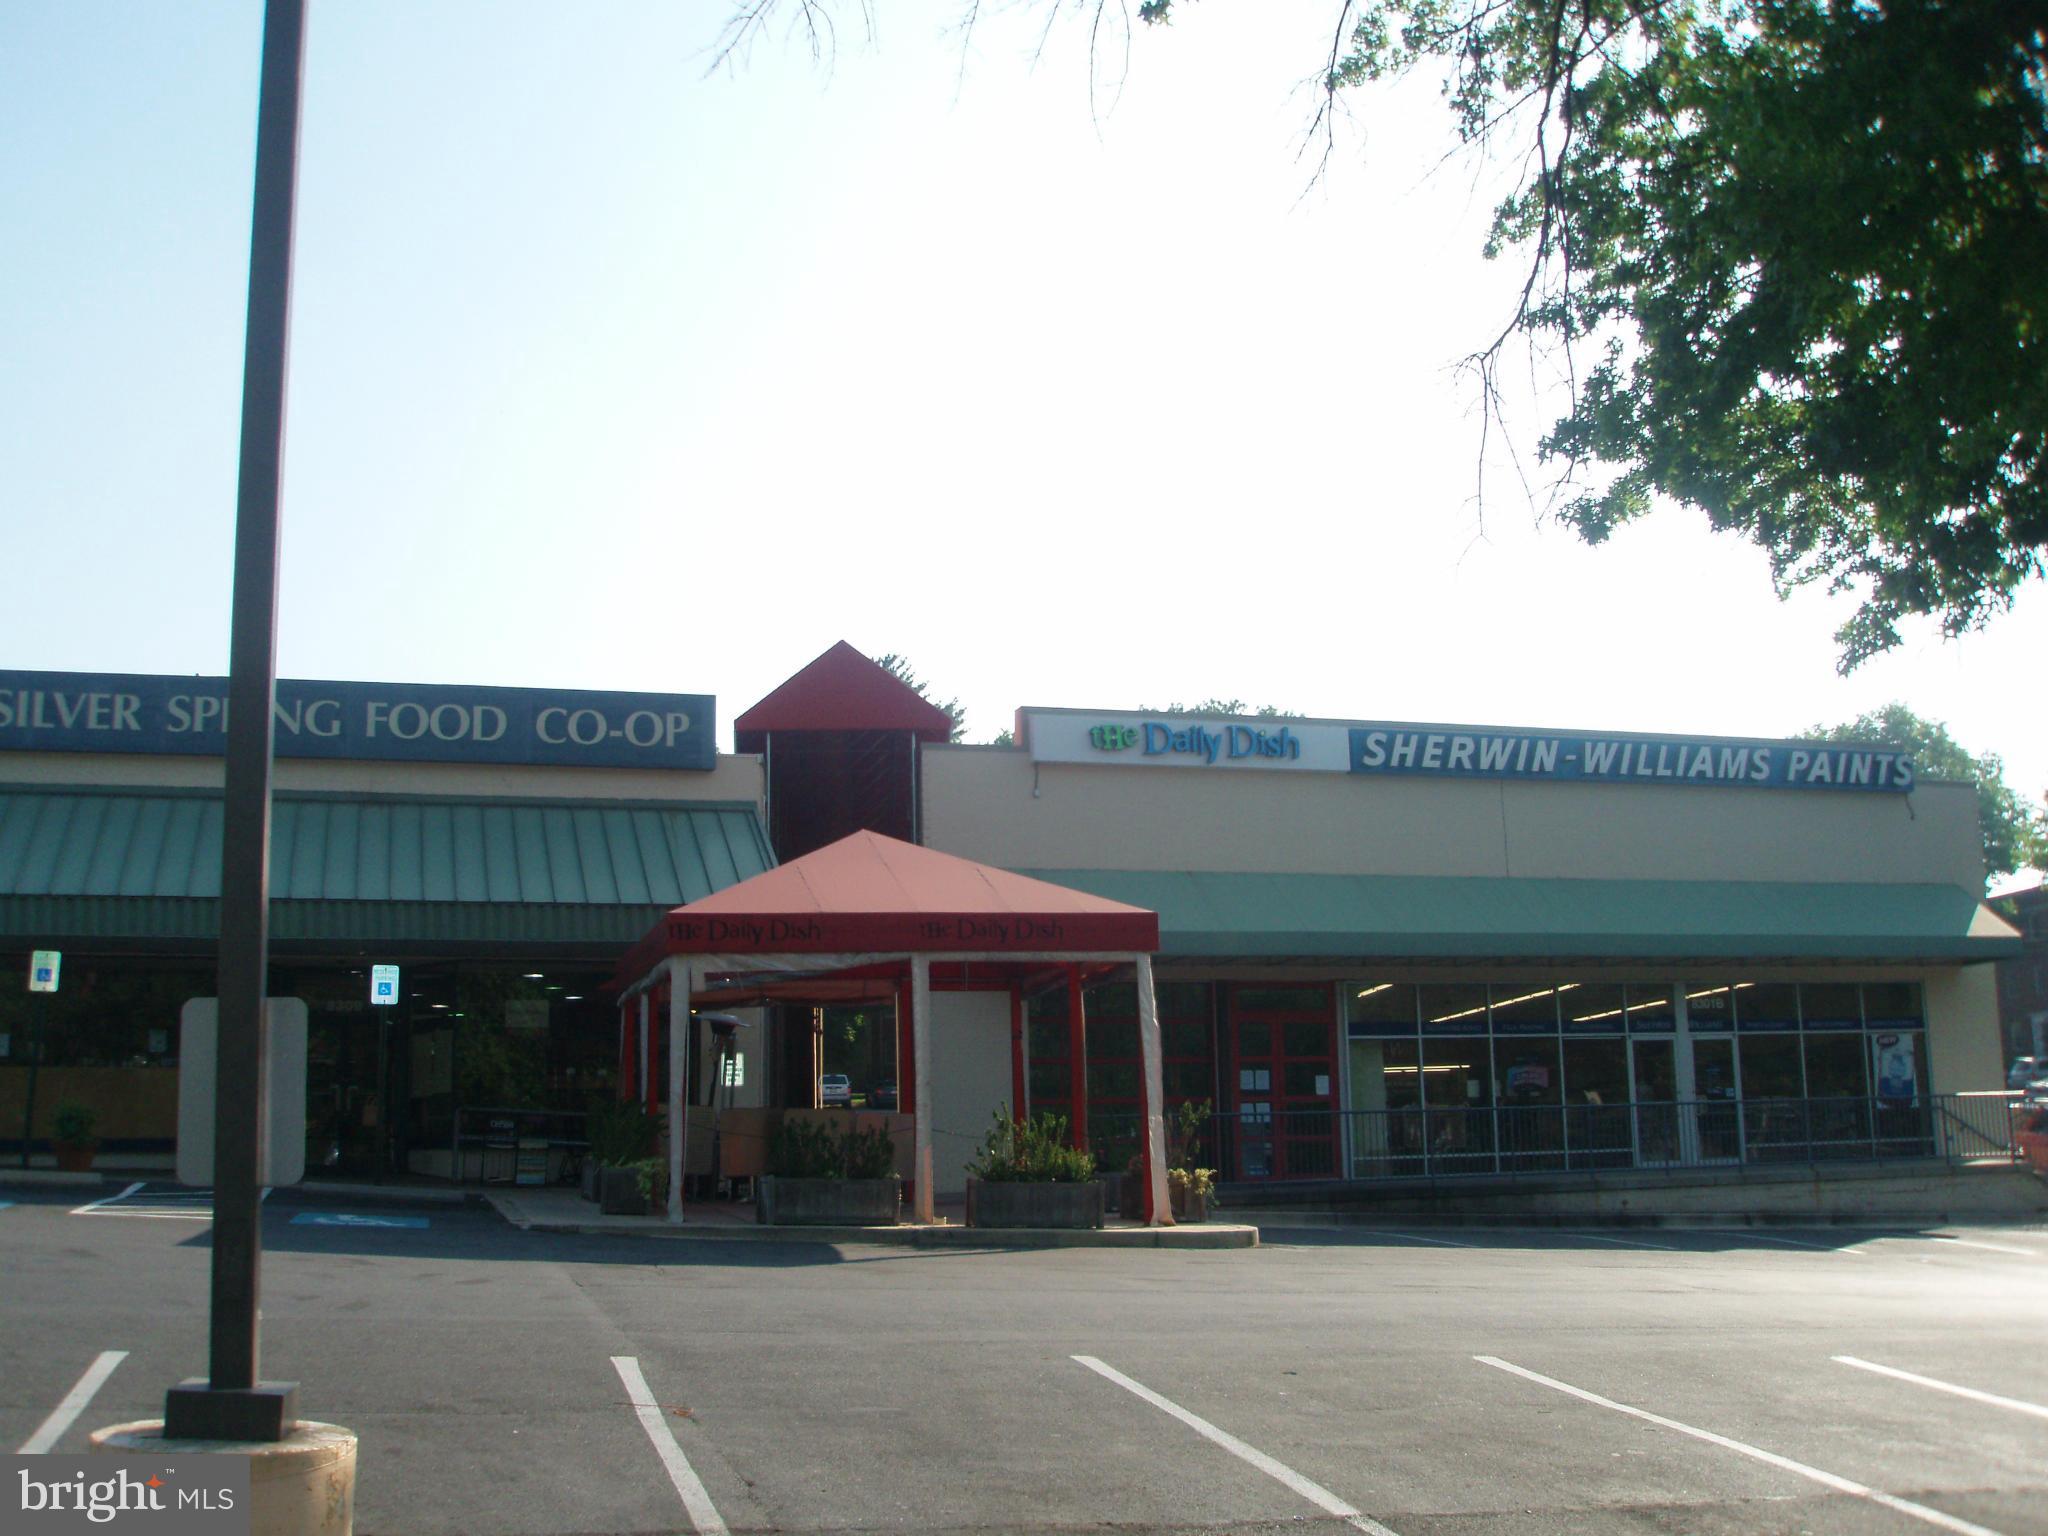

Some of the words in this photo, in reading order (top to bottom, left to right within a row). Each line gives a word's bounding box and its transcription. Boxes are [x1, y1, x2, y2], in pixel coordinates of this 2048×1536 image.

[0, 689, 141, 731] SILVER
[167, 695, 341, 737] SPNG
[365, 701, 507, 741] FOOD
[535, 708, 690, 747] CO-OP
[1142, 722, 1222, 764] Daily
[1225, 724, 1300, 760] Dish
[1362, 732, 1772, 781] SHERWIN-WILLIAMS
[1787, 751, 1913, 786] PAINTS
[707, 919, 764, 945] Daily
[768, 918, 823, 942] Dish
[956, 918, 1009, 943] Daily
[1014, 917, 1064, 942] Dish
